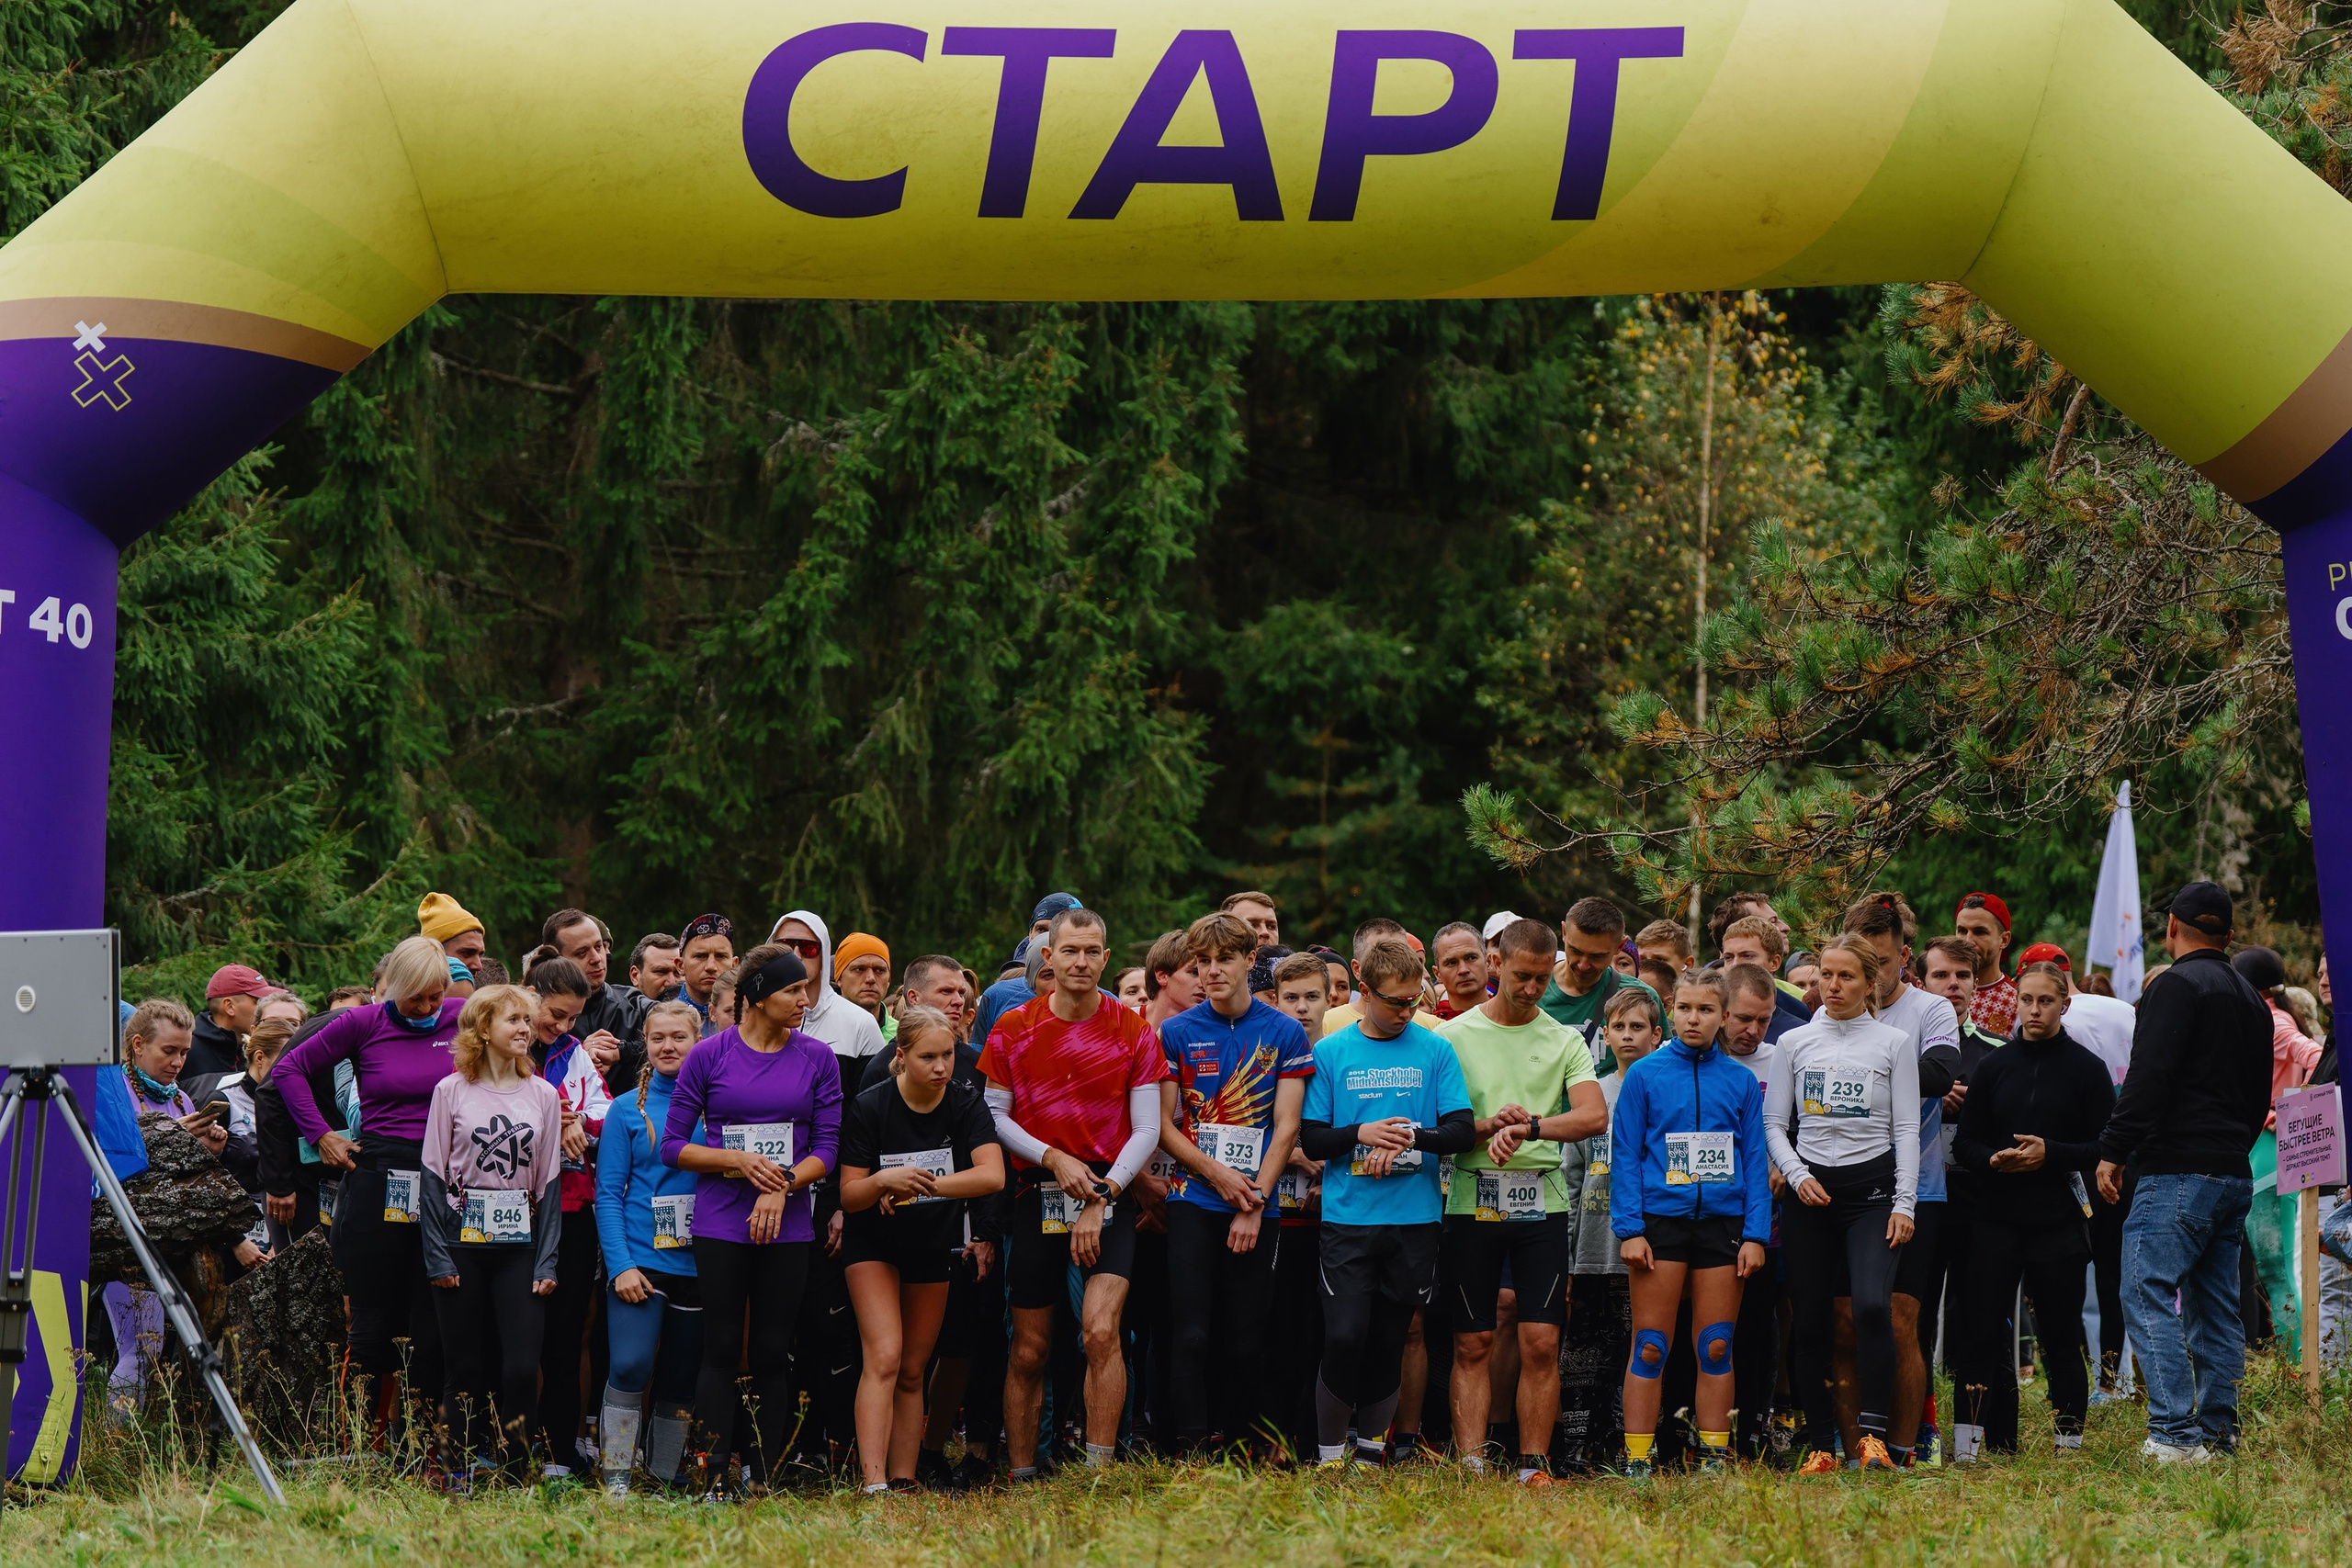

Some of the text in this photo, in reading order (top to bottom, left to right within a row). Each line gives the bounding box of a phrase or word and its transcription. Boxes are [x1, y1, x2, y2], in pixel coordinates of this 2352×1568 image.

[742, 22, 1685, 222] СТАРТ
[29, 596, 93, 649] 40
[1368, 1067, 1422, 1079] Stockholm
[1831, 1081, 1864, 1097] 239
[2288, 1113, 2323, 1134] БЕГУЩИЕ
[479, 1124, 524, 1162] АТОМНЫЙ ТРЕЙЛ
[2278, 1126, 2335, 1152] БЫСТРЕЕ ВЕТРА
[753, 1140, 786, 1156] 322
[1224, 1142, 1254, 1158] 373
[1697, 1149, 1726, 1163] 234
[2301, 1156, 2320, 1168] ВЫСОКИЙ
[2320, 1154, 2331, 1164] ТЕМП
[1673, 1174, 1685, 1182] 5K
[1507, 1187, 1537, 1201] 400
[492, 1209, 522, 1223] 846
[468, 1232, 479, 1240] 5K
